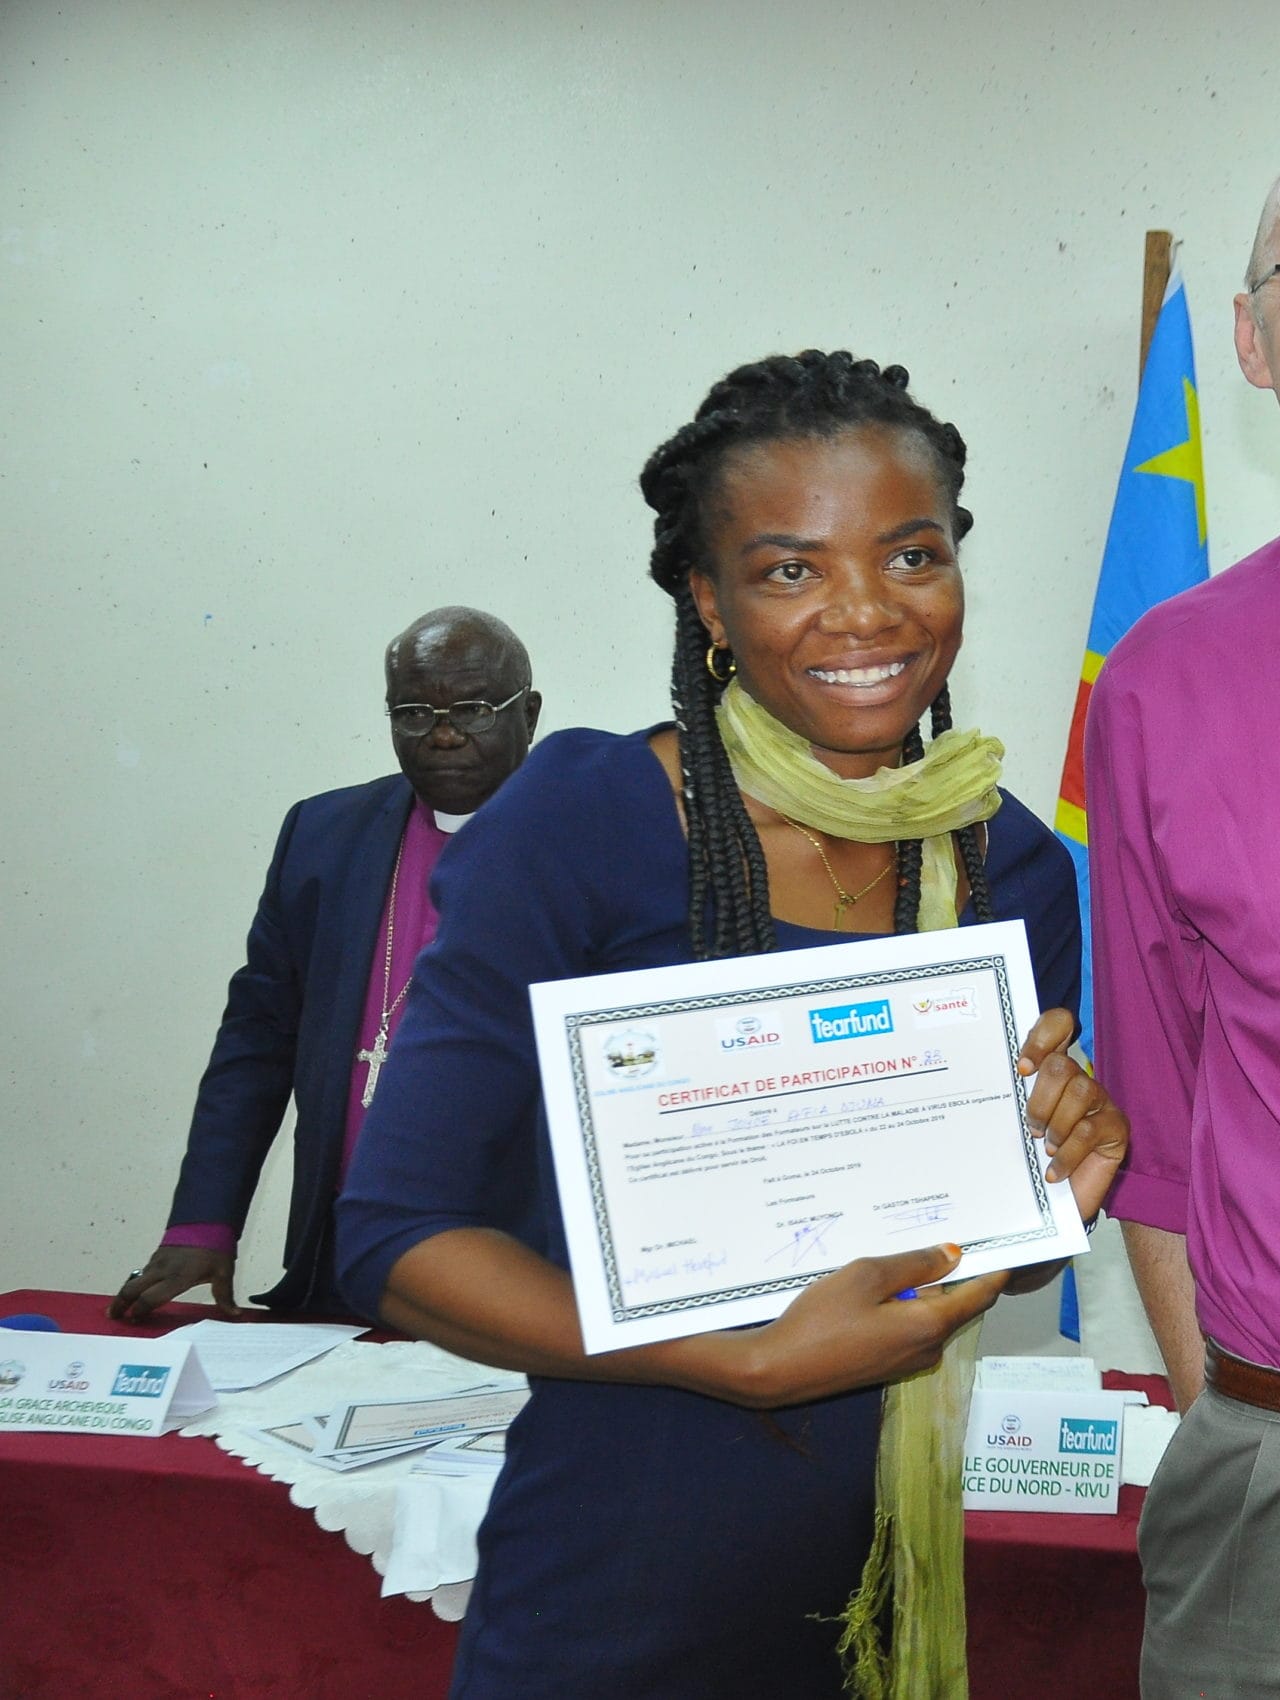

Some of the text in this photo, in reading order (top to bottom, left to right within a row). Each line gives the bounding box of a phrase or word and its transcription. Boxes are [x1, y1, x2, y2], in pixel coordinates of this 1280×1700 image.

[936, 1000, 968, 1011] santé
[812, 1005, 890, 1039] tearfund
[722, 1032, 780, 1048] USAID
[659, 1081, 750, 1106] CERTIFICAT
[755, 1078, 776, 1091] DE
[781, 1059, 897, 1088] PARTICIPATION
[48, 1380, 90, 1391] USAID
[116, 1368, 168, 1393] tearfund
[17, 1399, 53, 1410] GRACE
[27, 1413, 90, 1427] ANGLICANE
[90, 1416, 109, 1428] DU
[111, 1417, 153, 1431] CONGO
[987, 1434, 1032, 1447] USAID
[1061, 1421, 1115, 1451] tearfund
[965, 1456, 1114, 1478] LE GOUVERNEUR DE
[990, 1478, 1013, 1494] DU
[1016, 1480, 1062, 1496] NORD
[1075, 1482, 1110, 1498] KIVU
